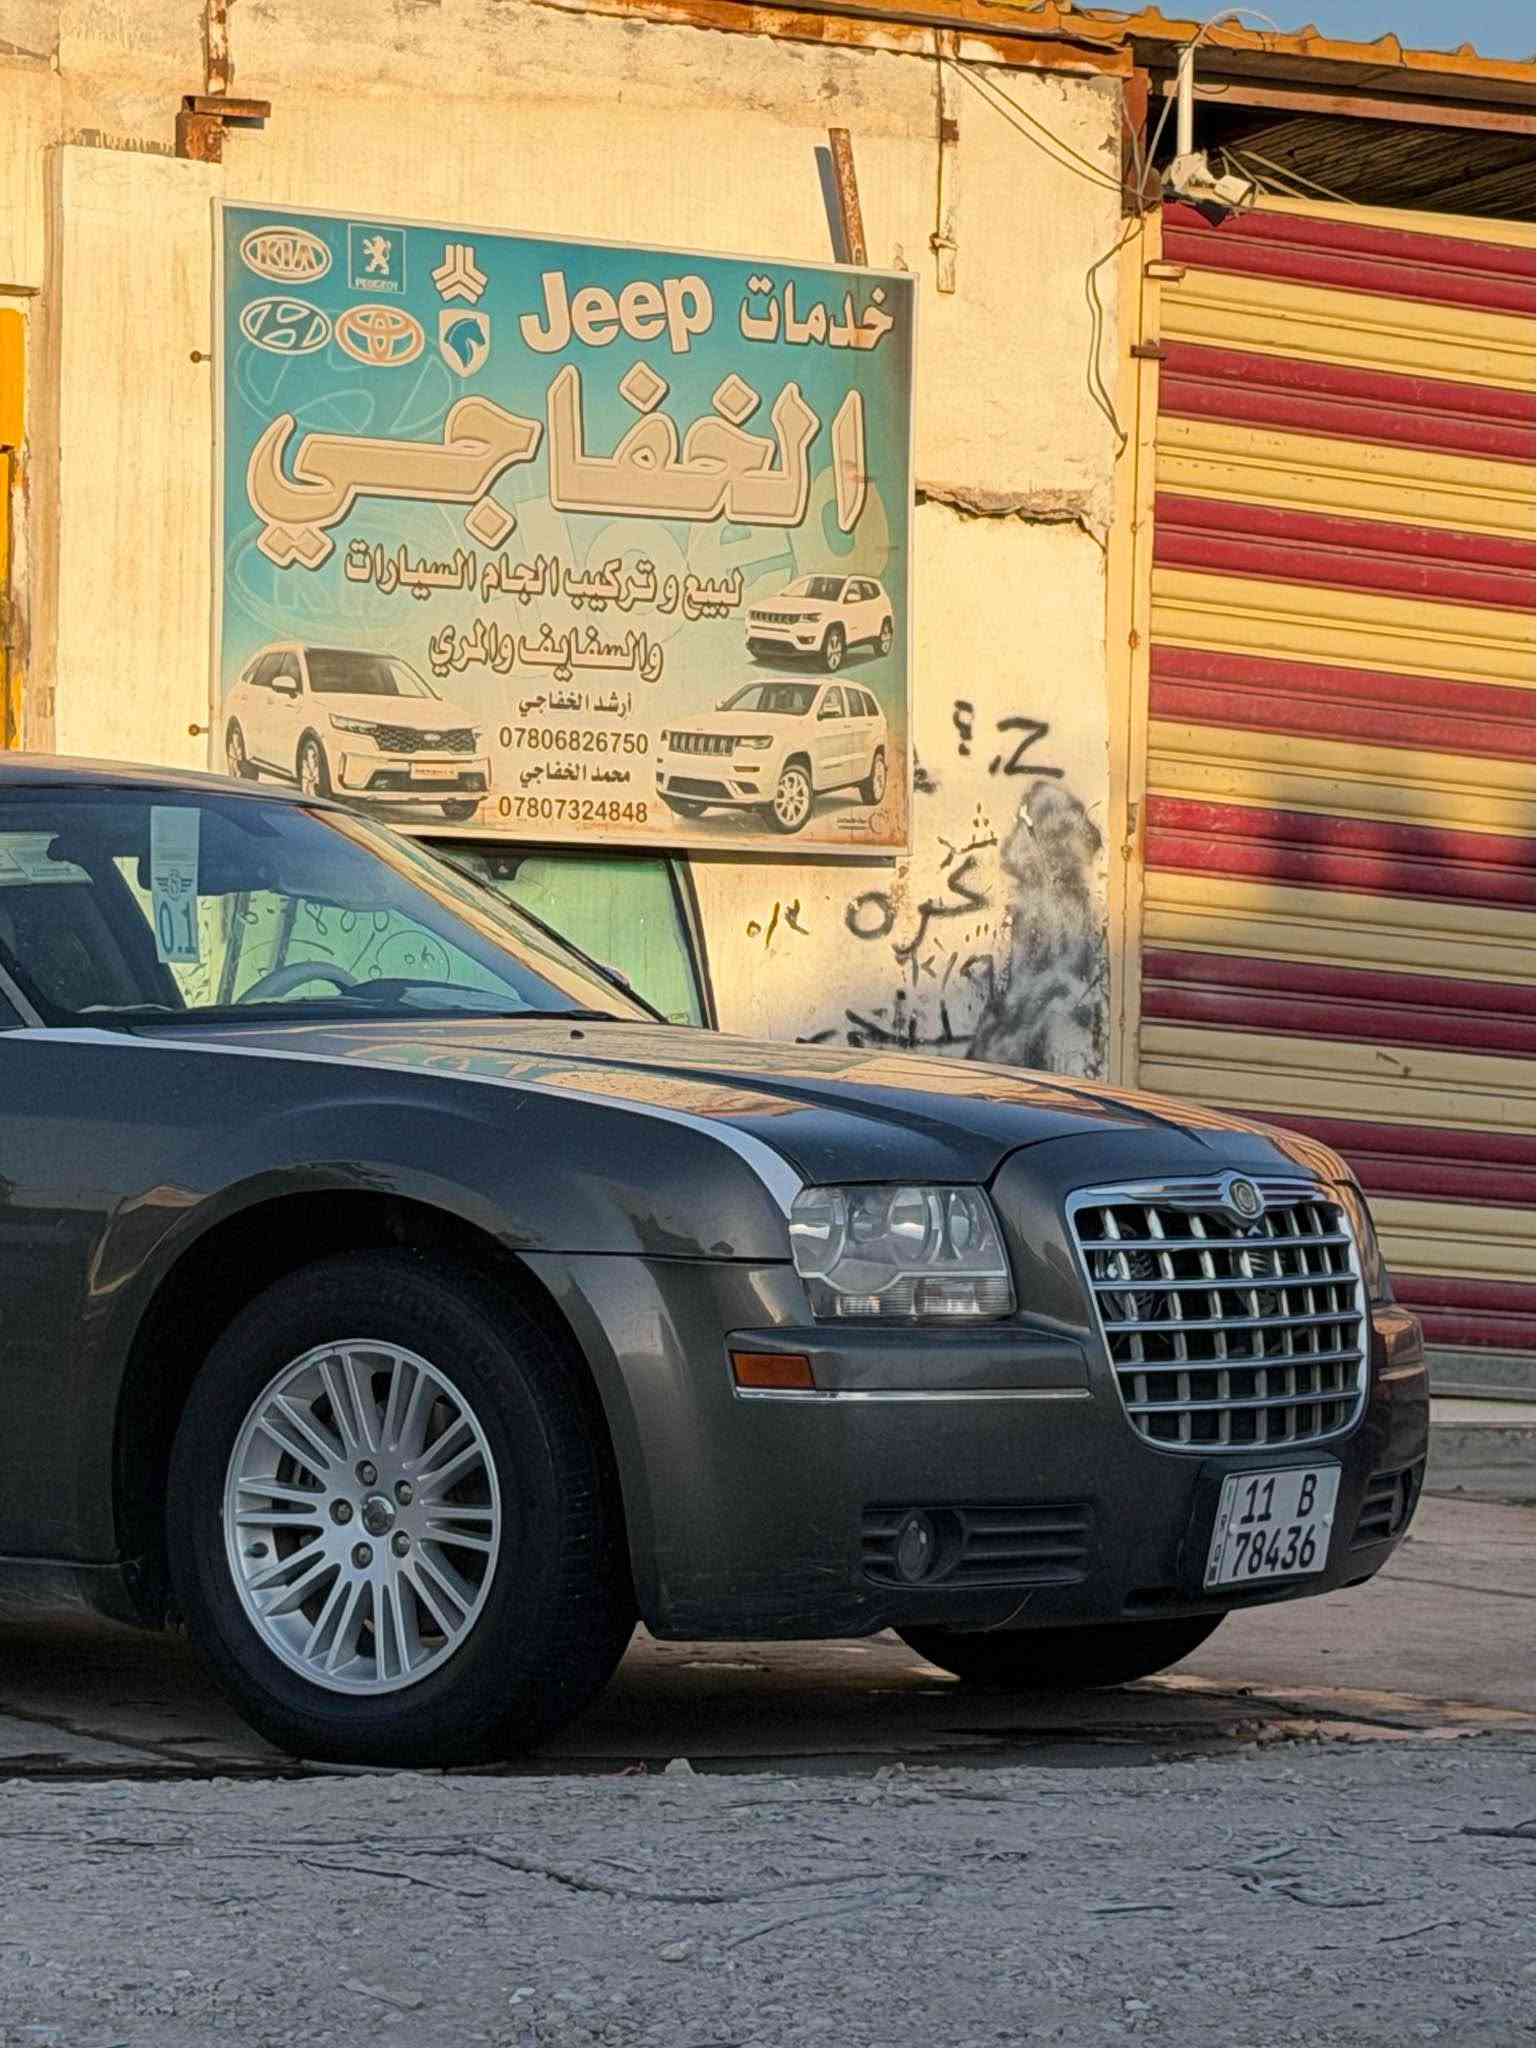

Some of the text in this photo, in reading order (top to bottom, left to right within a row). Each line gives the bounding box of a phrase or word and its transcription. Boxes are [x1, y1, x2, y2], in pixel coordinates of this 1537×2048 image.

[255, 238, 317, 272] KIA
[519, 270, 895, 354] خدمات Jeep
[246, 359, 868, 570] الخفاجي
[344, 538, 477, 601] السيارات
[480, 551, 559, 606] الجام
[682, 566, 745, 621] لبيع
[518, 689, 590, 717] الخفاجي
[499, 726, 649, 755] 07806826750
[519, 760, 631, 789] محمد الخفاجي
[499, 795, 649, 824] 07807324848
[1240, 1472, 1318, 1525] 11 B
[1231, 1523, 1317, 1578] 78436
